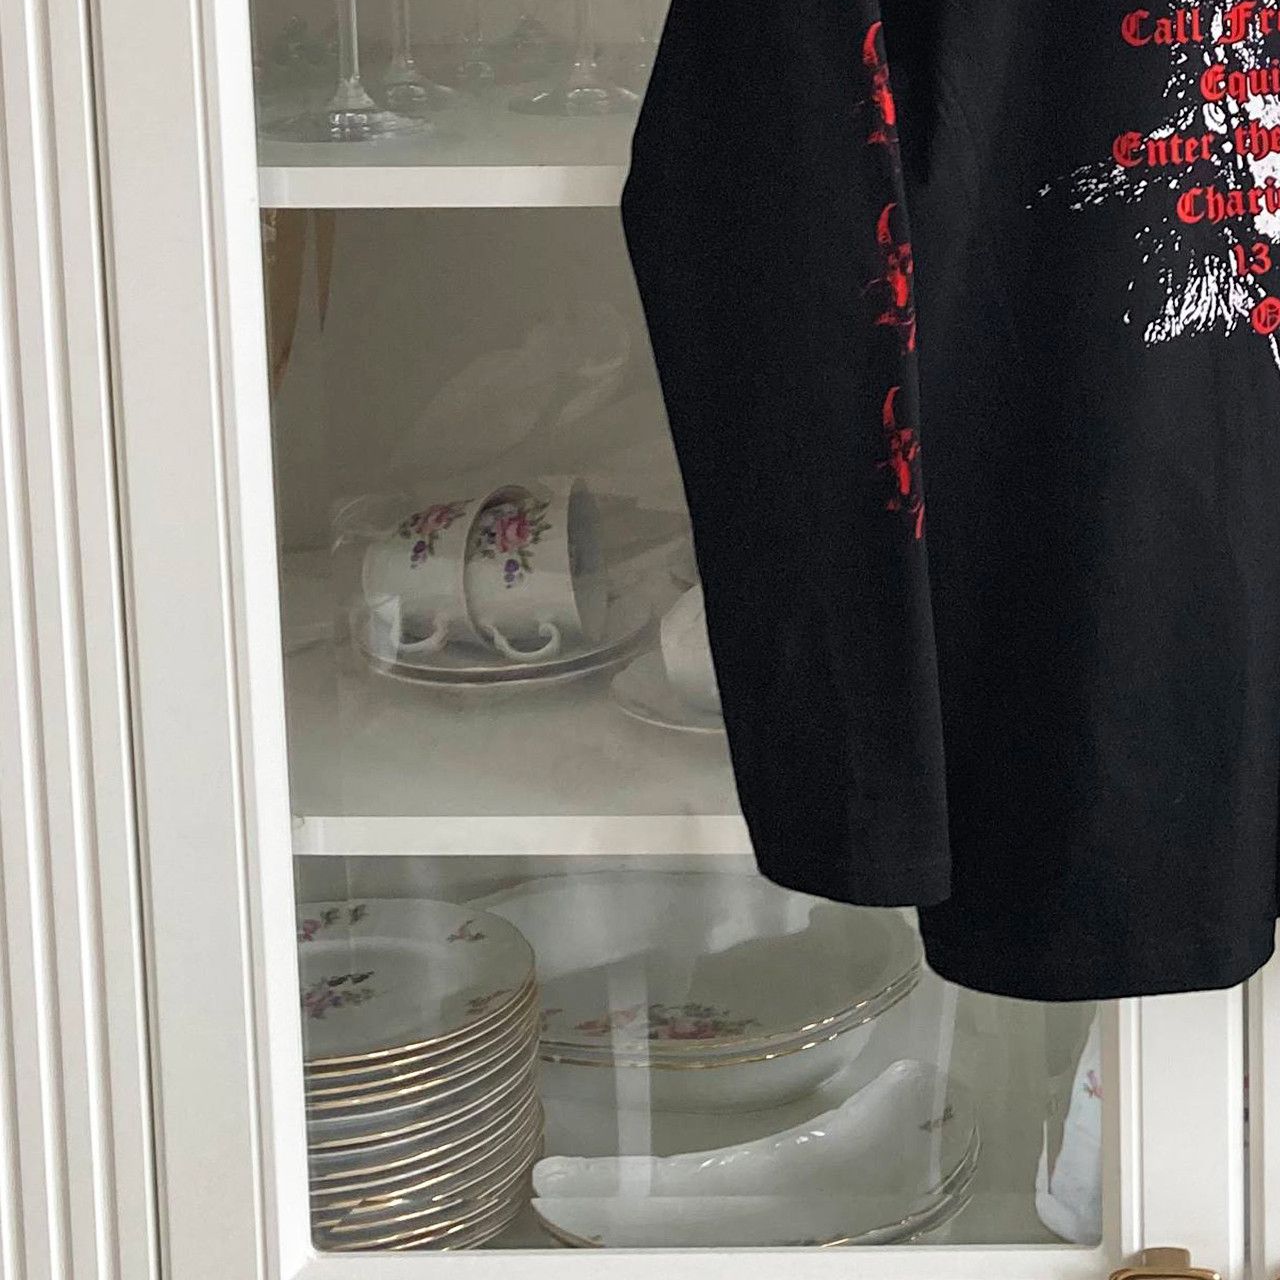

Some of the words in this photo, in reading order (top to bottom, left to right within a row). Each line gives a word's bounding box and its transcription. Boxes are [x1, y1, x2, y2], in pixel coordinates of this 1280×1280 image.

[1121, 7, 1203, 46] Call
[1112, 131, 1214, 167] Enter
[1234, 242, 1272, 275] 13
